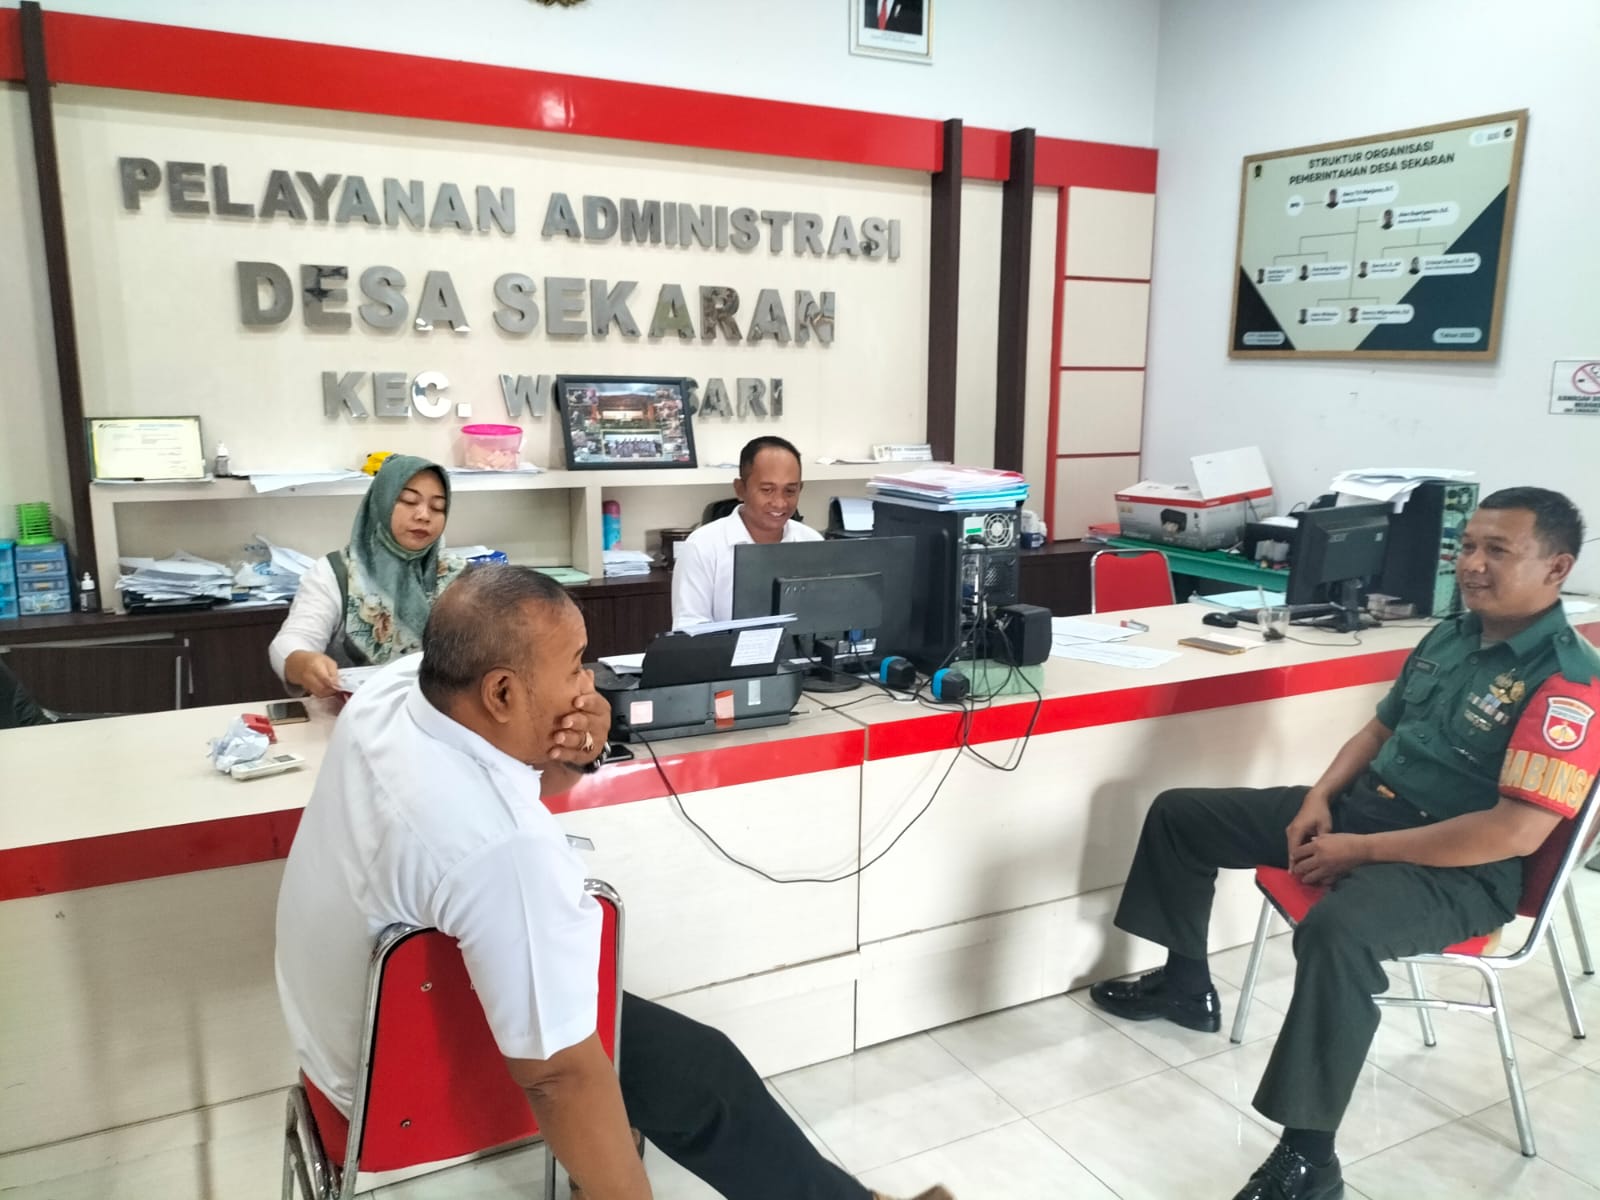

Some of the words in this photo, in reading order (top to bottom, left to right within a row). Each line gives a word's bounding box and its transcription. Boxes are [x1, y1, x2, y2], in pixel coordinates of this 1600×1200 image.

[1288, 165, 1368, 185] PEMERINTAHAN
[1369, 160, 1399, 175] DESA
[1400, 152, 1456, 170] SEKARAN
[1308, 152, 1362, 169] STRUKTUR
[1364, 140, 1434, 160] ORGANISASI
[118, 156, 516, 235] PELAYANAN
[541, 192, 901, 260] ADMINISTRASI
[236, 261, 473, 334] DESA
[493, 272, 836, 345] SEKARAN
[322, 371, 472, 419] KEC.
